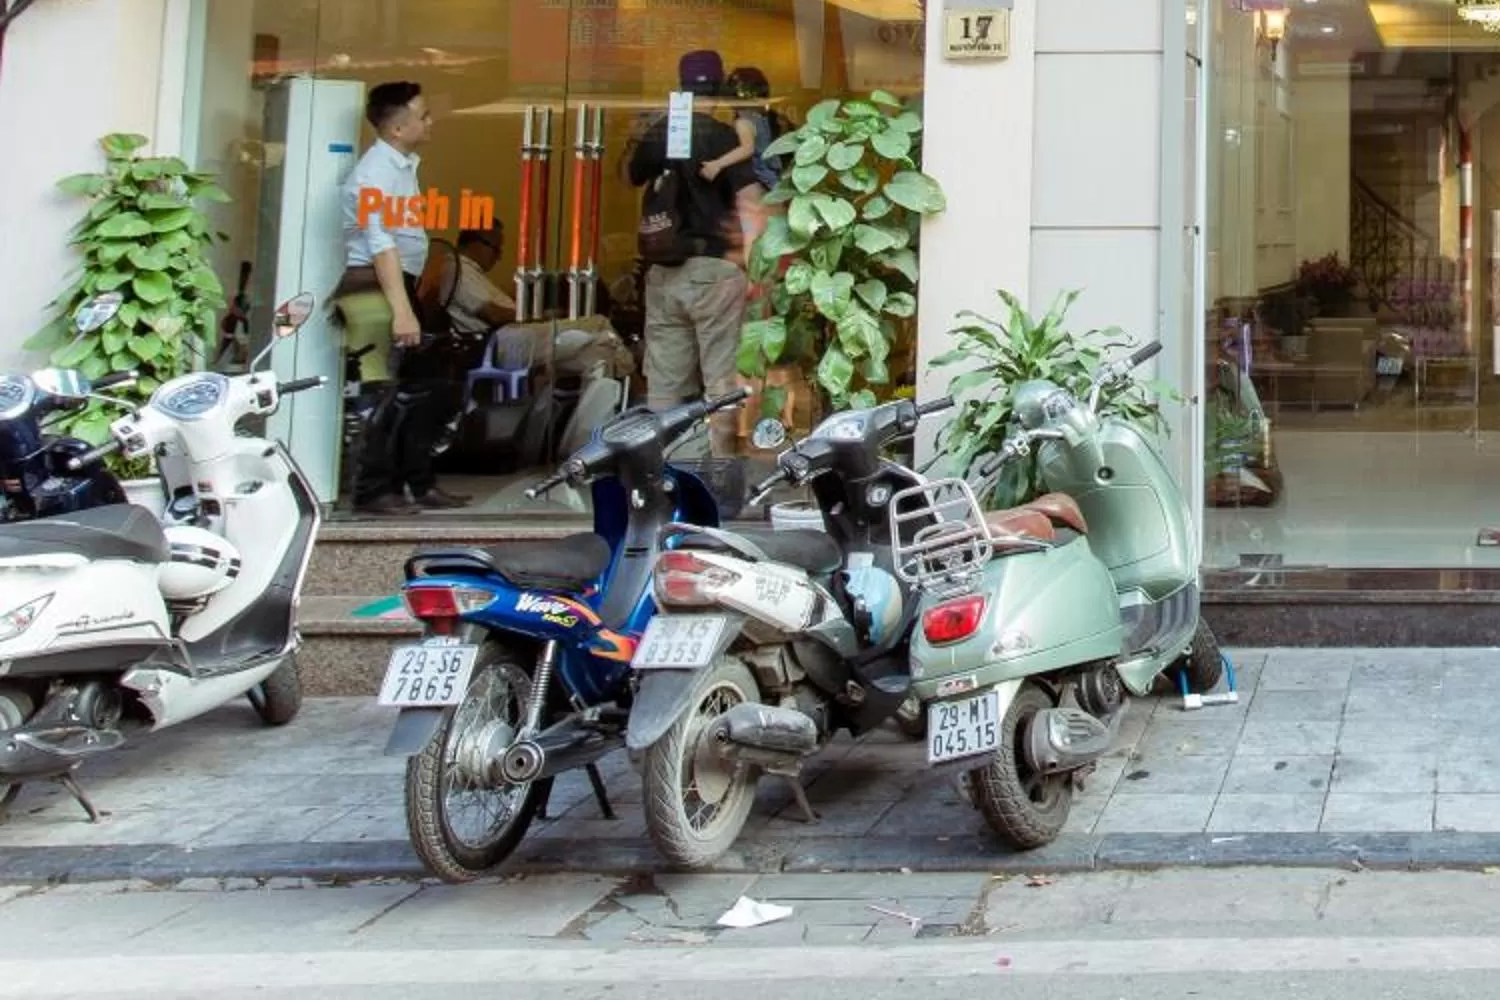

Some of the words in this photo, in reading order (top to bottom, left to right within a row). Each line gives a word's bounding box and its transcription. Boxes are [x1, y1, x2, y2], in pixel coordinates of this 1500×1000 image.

[959, 15, 994, 40] 17
[356, 184, 449, 231] Push
[459, 185, 494, 231] in
